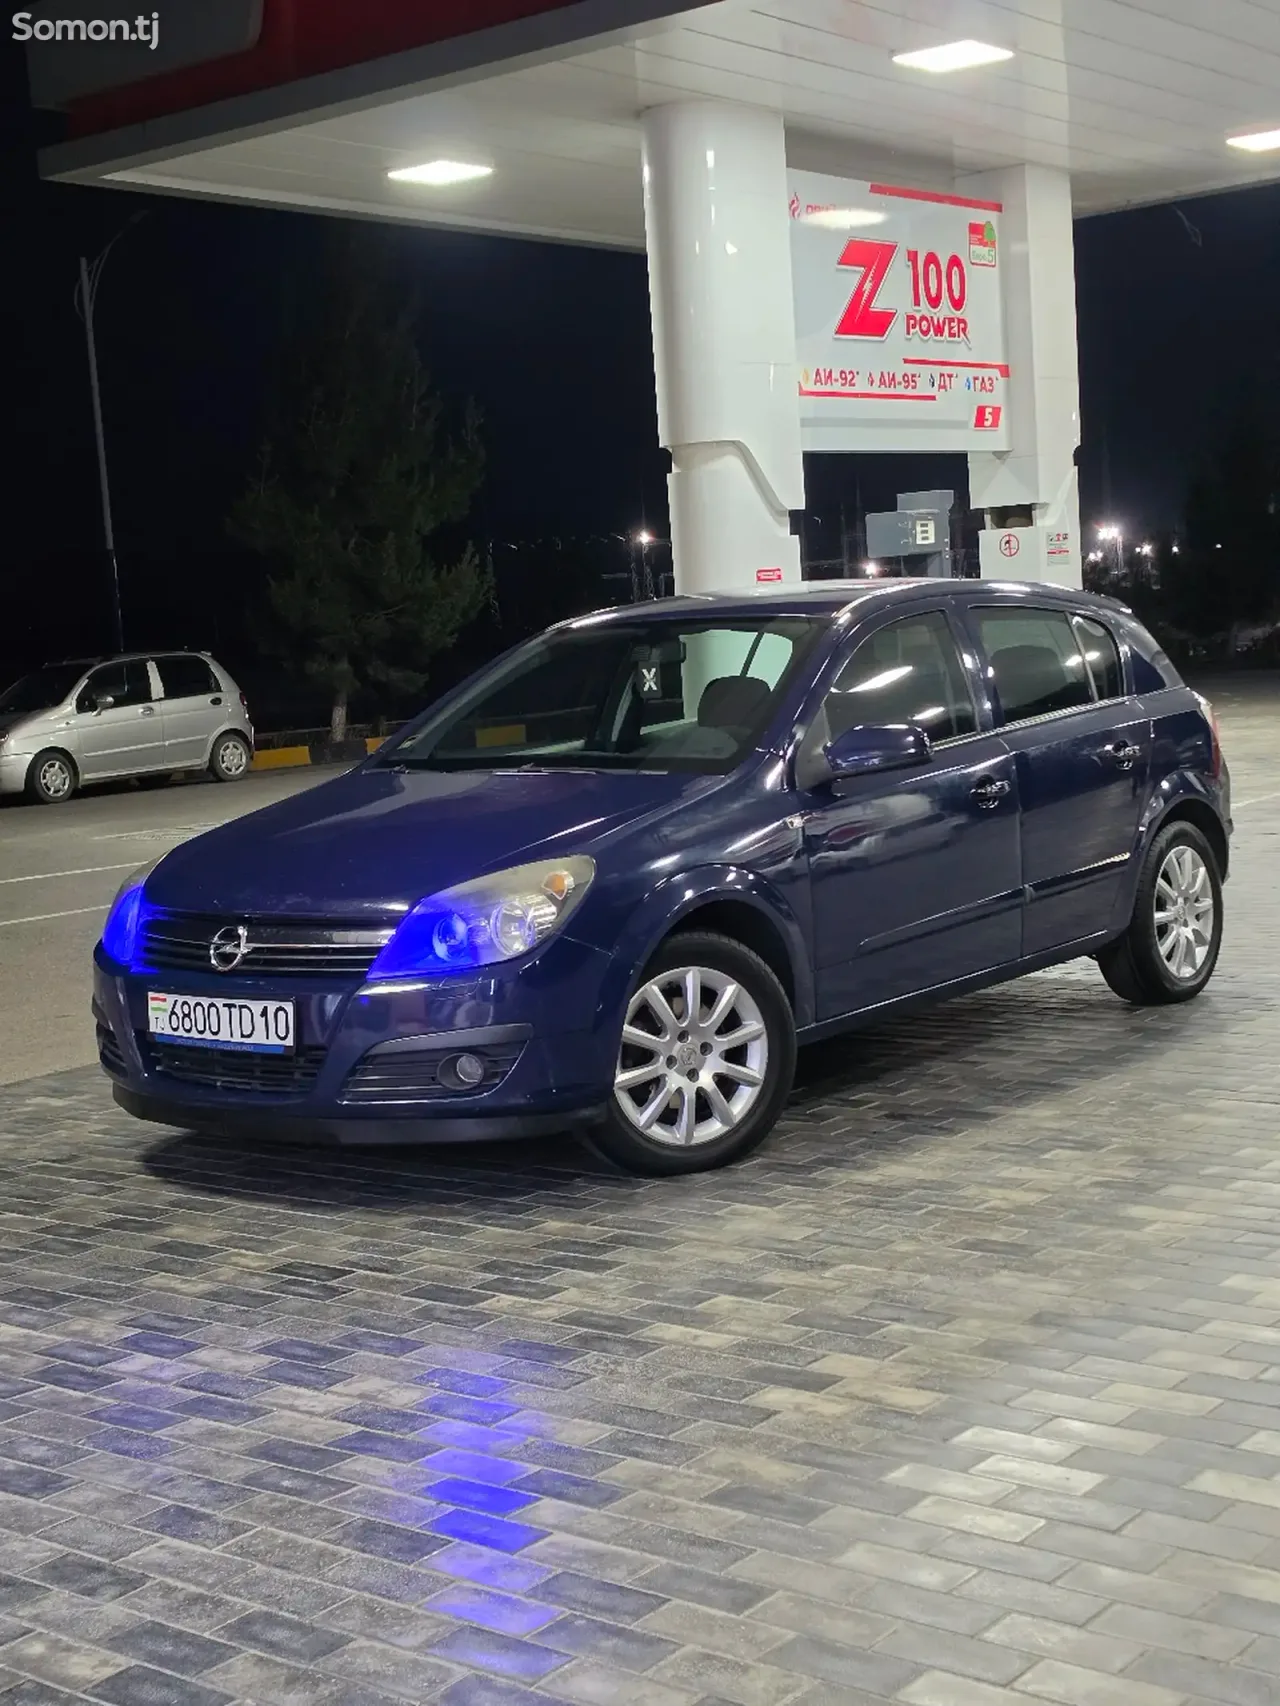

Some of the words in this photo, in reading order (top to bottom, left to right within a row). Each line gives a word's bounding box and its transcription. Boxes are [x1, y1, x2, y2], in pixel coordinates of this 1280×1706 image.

[835, 238, 898, 338] Z
[907, 250, 966, 311] 100
[905, 315, 971, 349] POWER
[983, 407, 993, 427] 5
